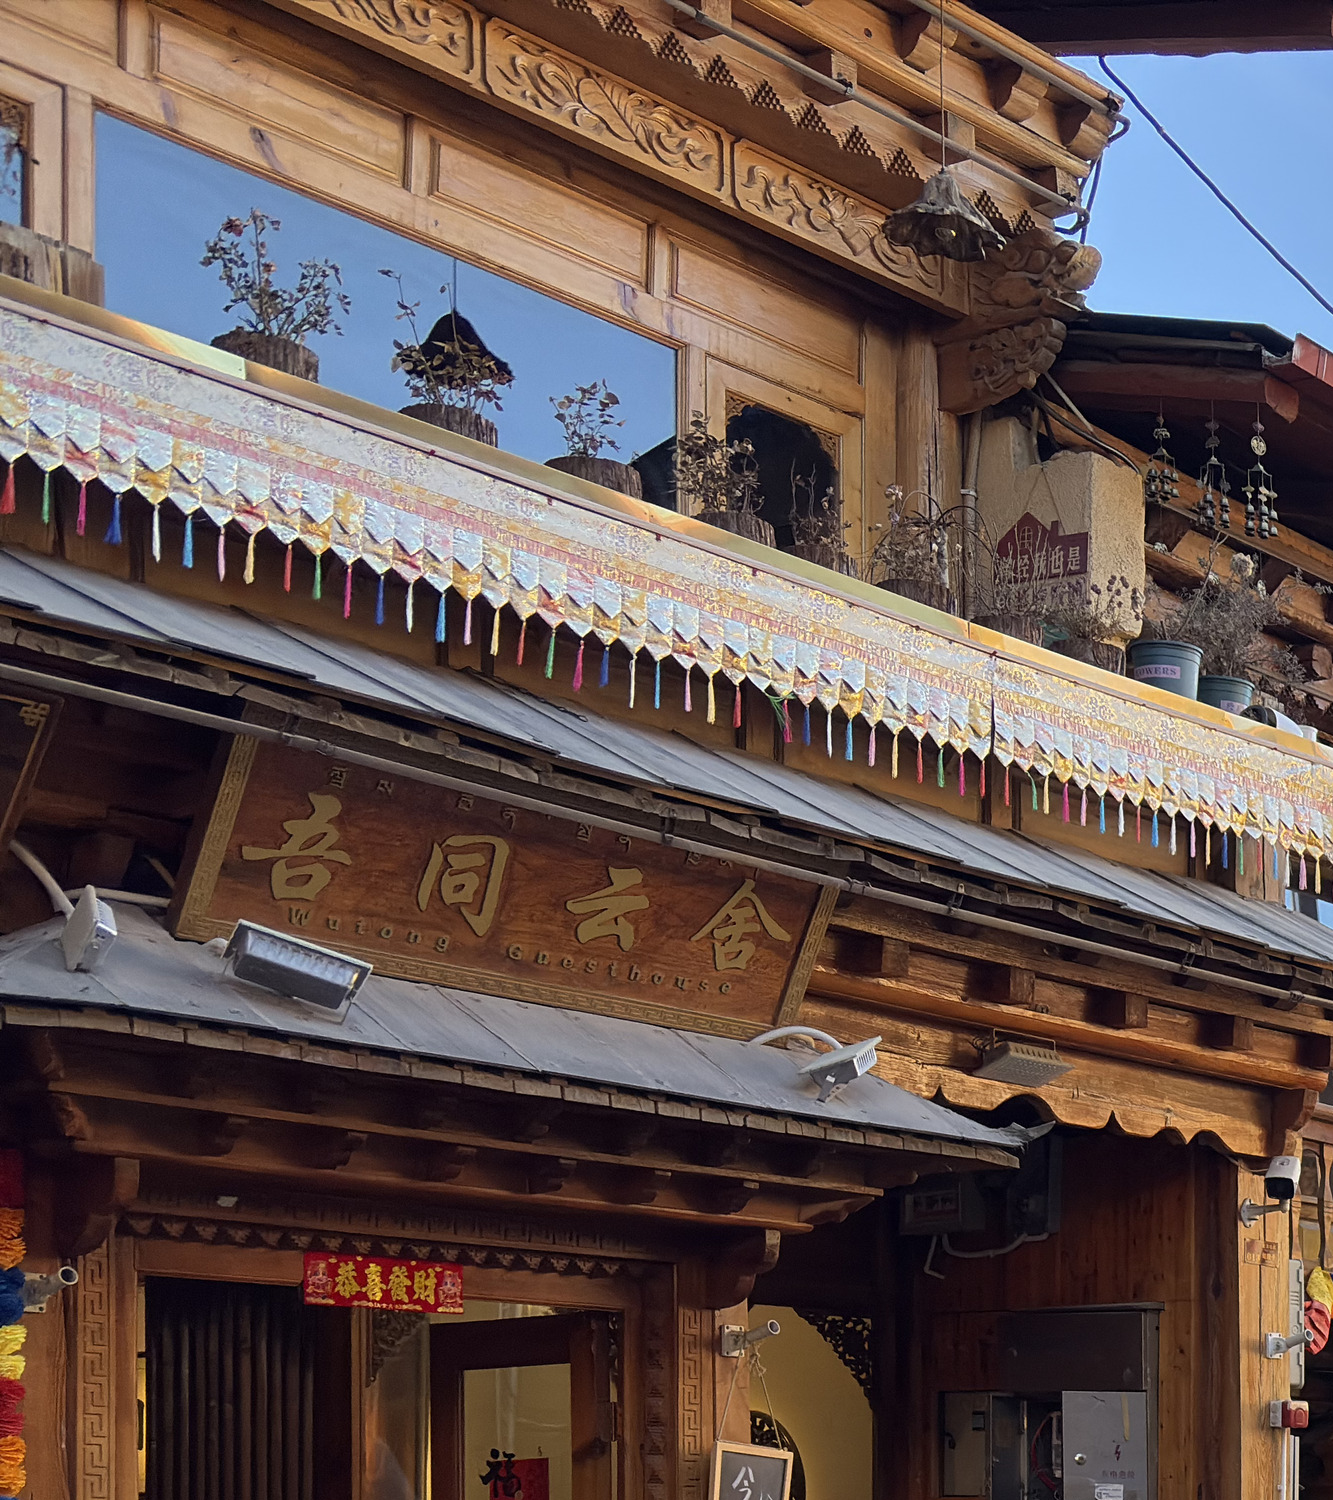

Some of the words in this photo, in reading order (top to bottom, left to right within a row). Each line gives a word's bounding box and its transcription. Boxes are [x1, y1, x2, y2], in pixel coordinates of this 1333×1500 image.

[241, 792, 792, 973] 吾同云舍
[288, 907, 453, 954] Wutong
[506, 942, 733, 997] Guesthouse
[334, 1261, 438, 1306] 恭喜發財
